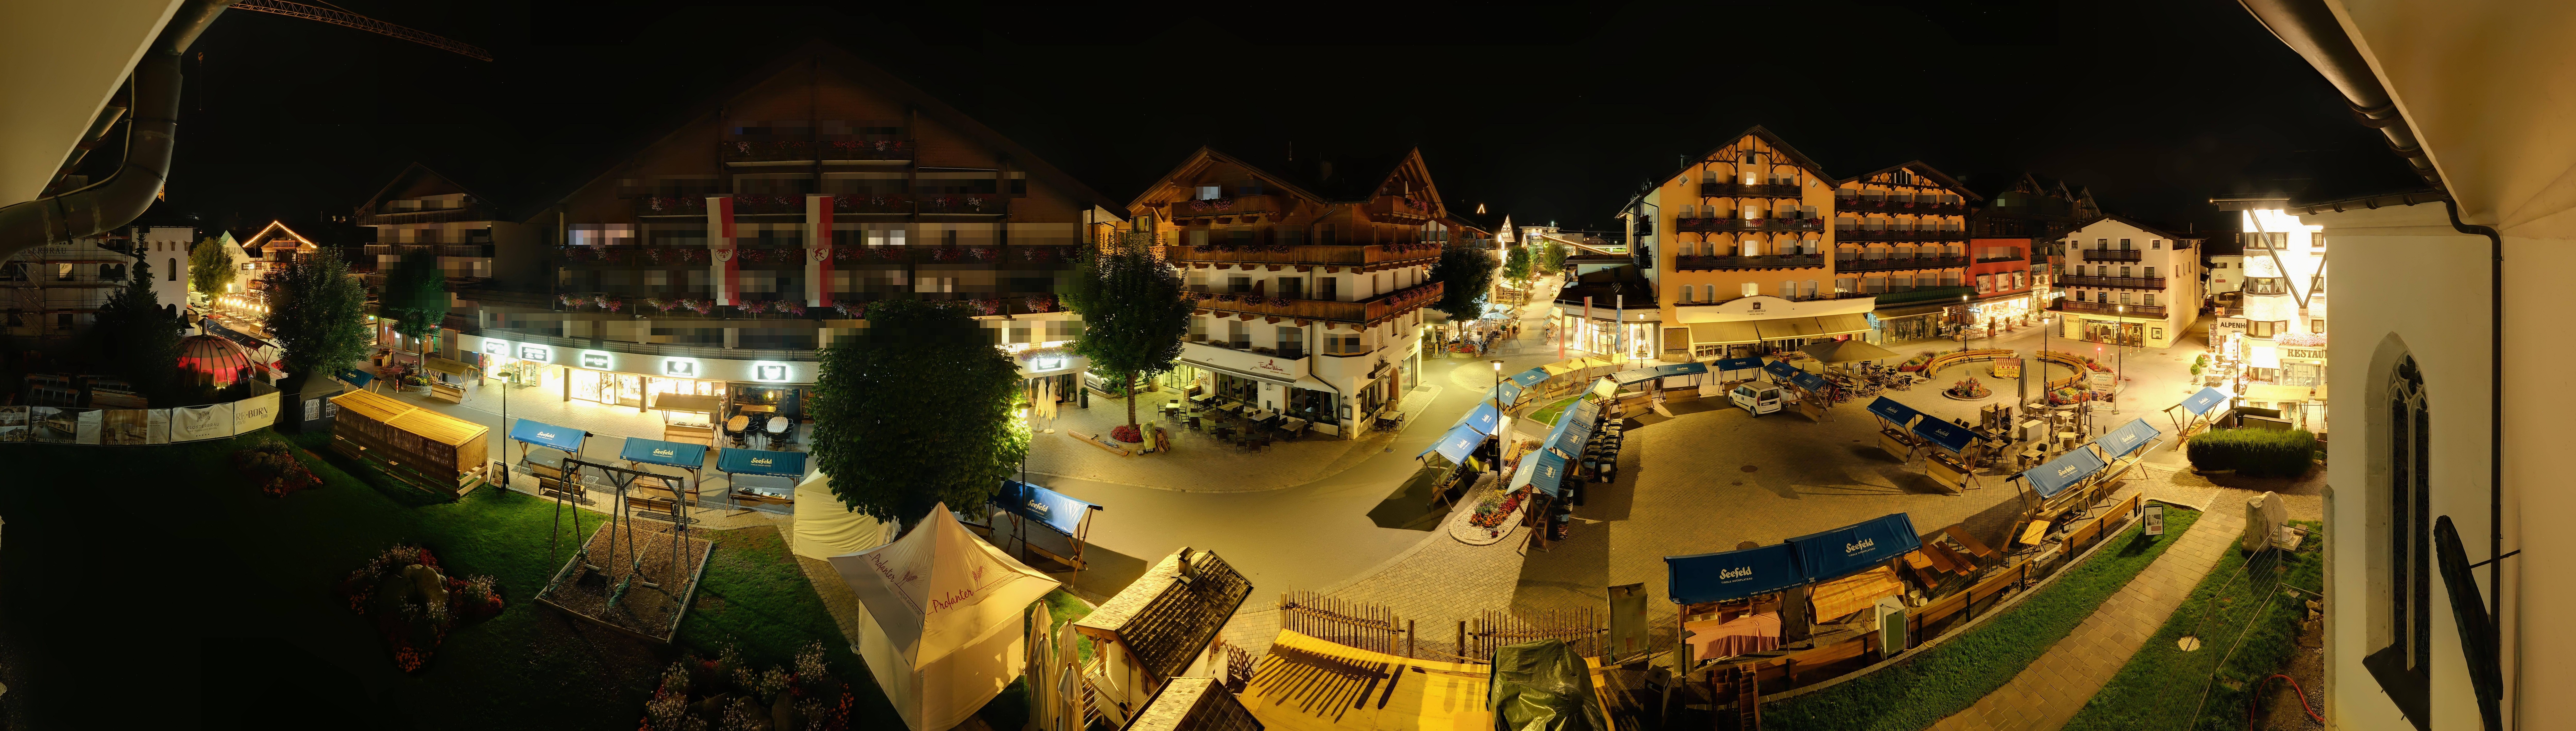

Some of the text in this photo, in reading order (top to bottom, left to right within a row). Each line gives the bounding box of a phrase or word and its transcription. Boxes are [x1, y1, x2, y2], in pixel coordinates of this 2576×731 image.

[1376, 364, 1389, 378] RESTAURANT
[2122, 434, 2135, 443] Seefeld
[2058, 465, 2076, 476] Seefeld
[1028, 499, 1049, 512] Seefeld
[1846, 538, 1874, 553] Seefeld
[873, 553, 896, 582] Profanter
[1719, 566, 1752, 580] Seefeld
[985, 573, 1015, 591] NATUR-BACKSTUBE
[898, 590, 921, 616] NATUR-BACKSTUBE
[933, 589, 974, 613] Profanter
